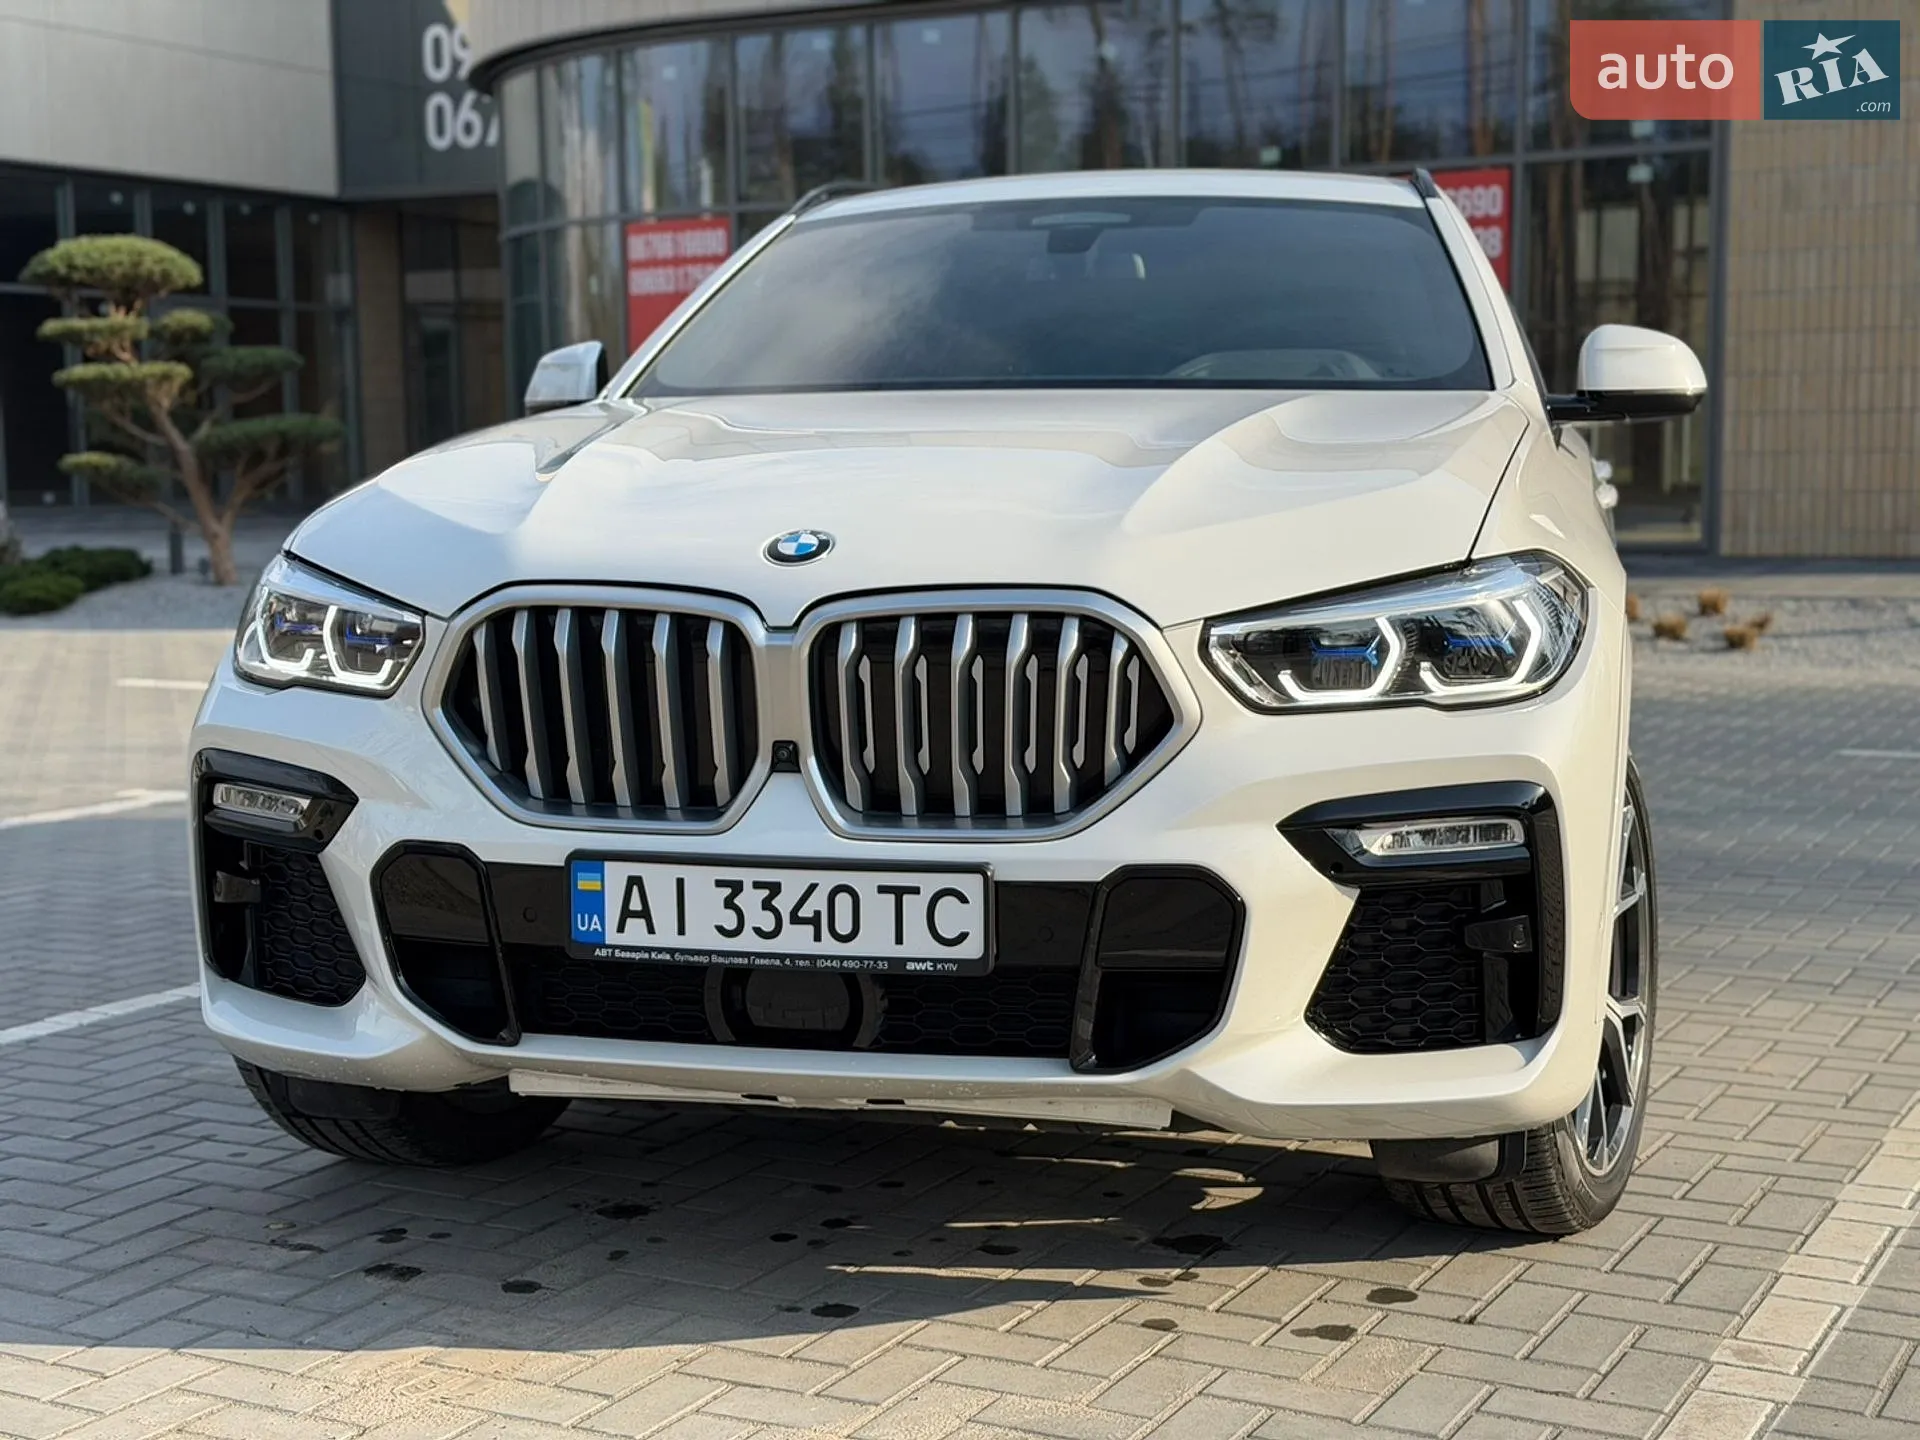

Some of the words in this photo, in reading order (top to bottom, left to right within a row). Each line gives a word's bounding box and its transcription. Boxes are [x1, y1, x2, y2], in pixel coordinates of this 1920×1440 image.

[615, 874, 687, 936] AI
[713, 878, 861, 944] 3340
[876, 884, 971, 948] TC
[576, 913, 602, 932] UA
[841, 960, 889, 970] 490-77-33
[906, 961, 934, 971] awt
